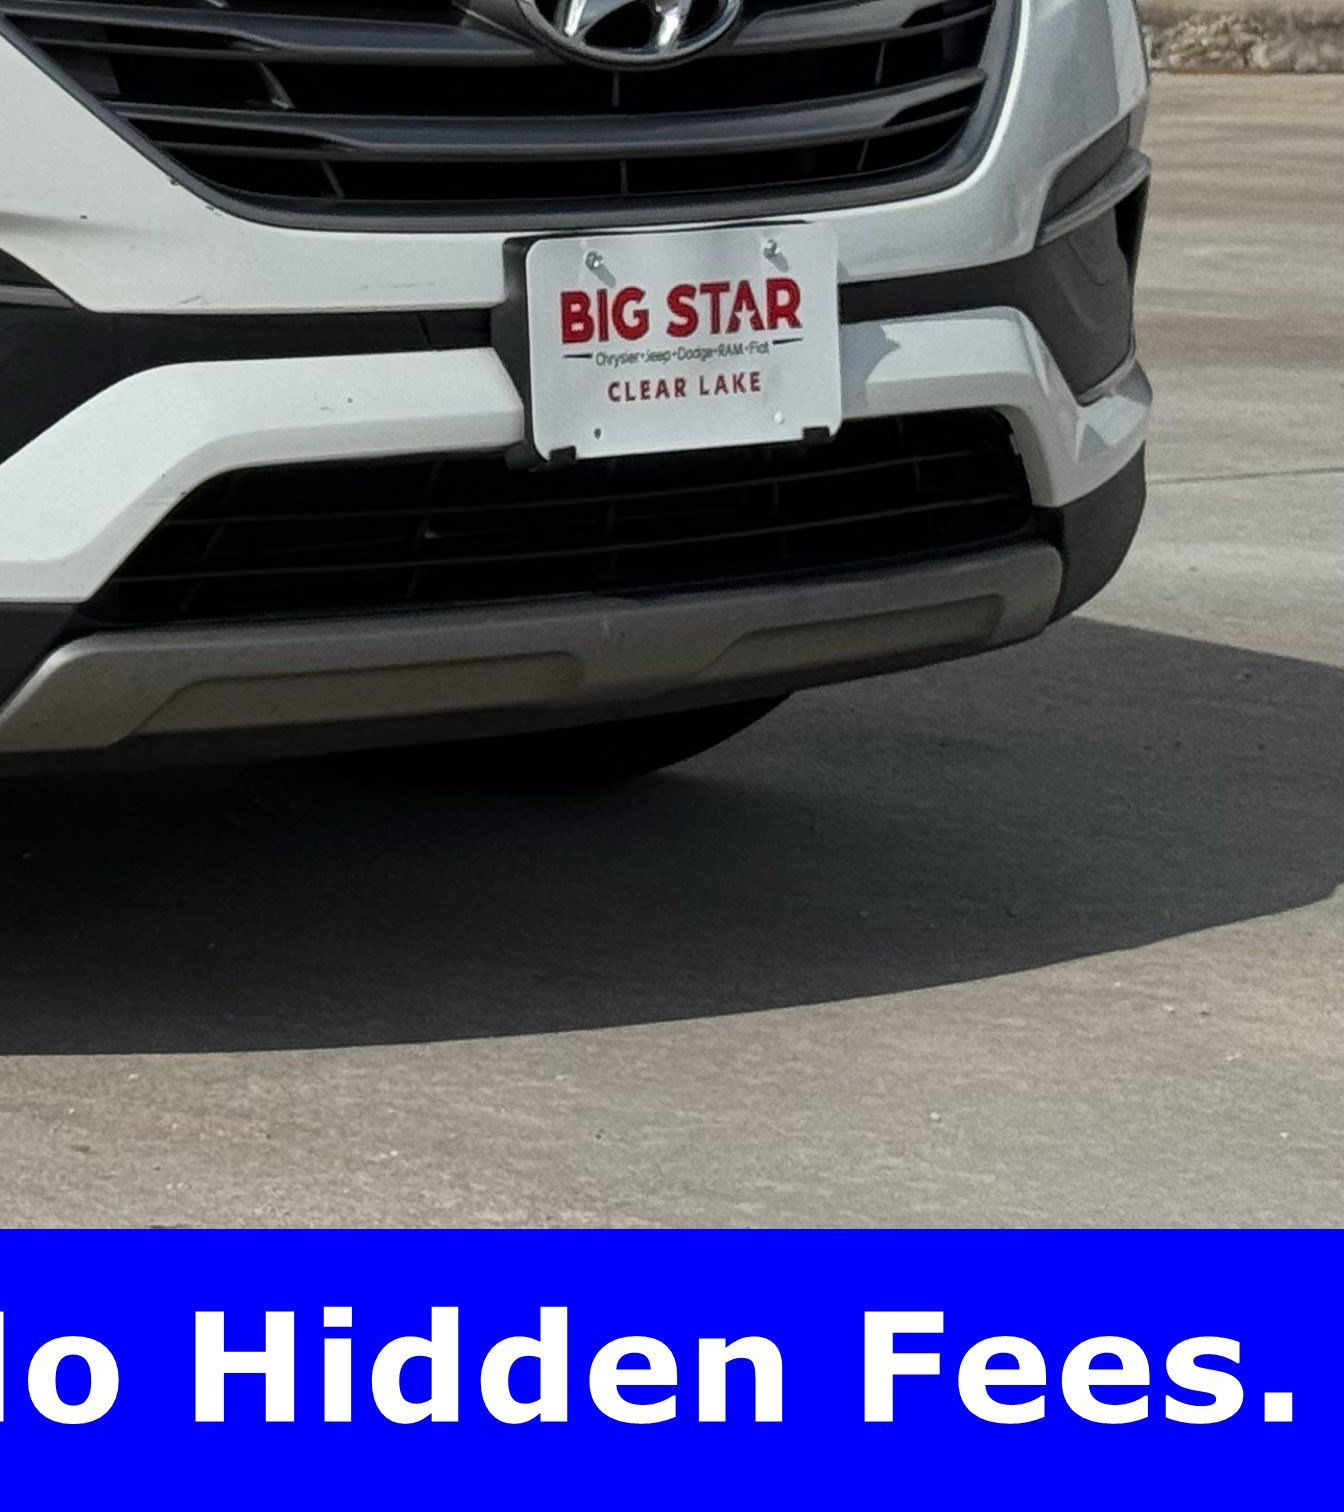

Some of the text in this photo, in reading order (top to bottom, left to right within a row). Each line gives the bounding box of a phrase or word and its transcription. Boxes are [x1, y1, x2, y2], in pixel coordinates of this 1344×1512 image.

[559, 276, 803, 345] BIG STAR
[607, 370, 763, 403] CLEAR LAKE
